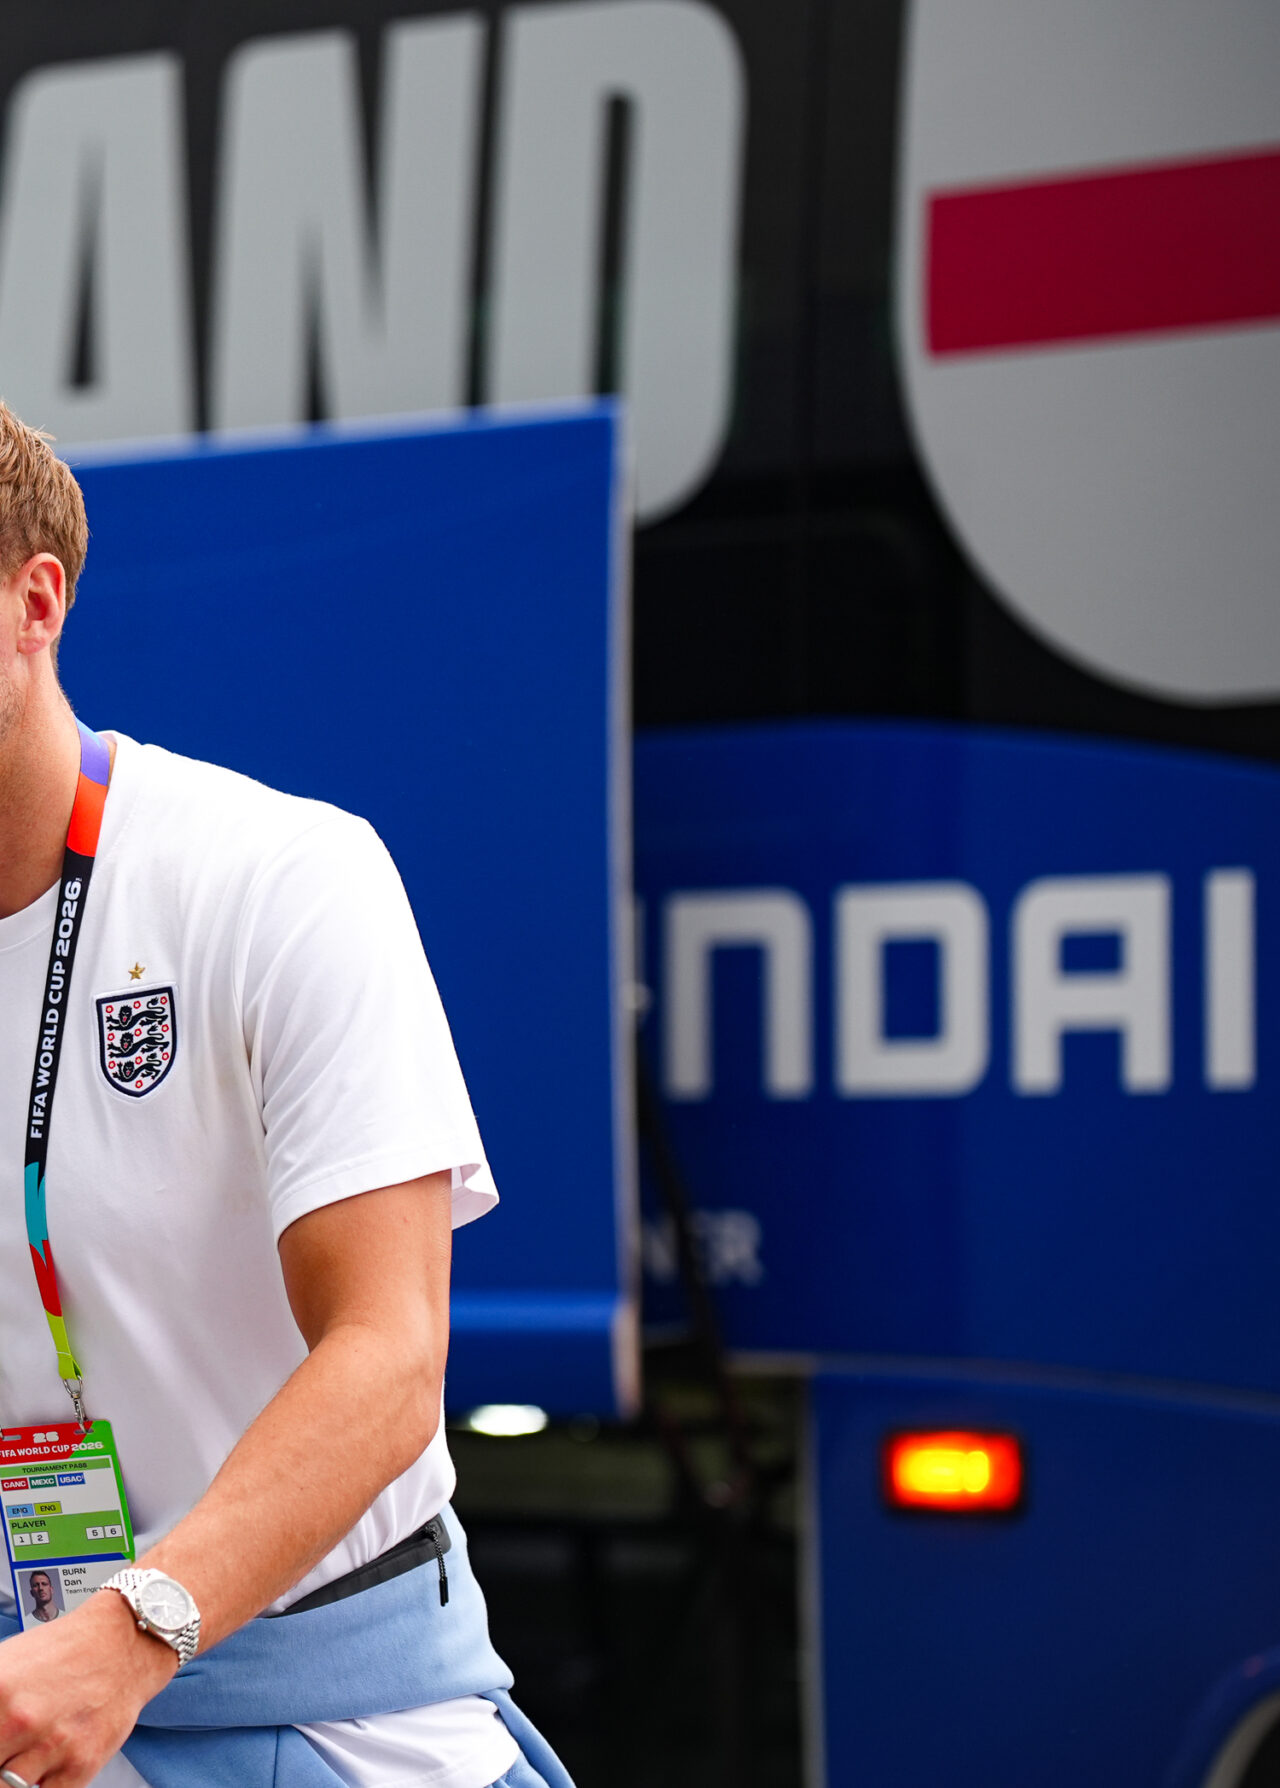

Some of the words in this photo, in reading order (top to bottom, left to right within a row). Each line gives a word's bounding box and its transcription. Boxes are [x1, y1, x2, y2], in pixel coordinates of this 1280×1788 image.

[55, 881, 82, 958] 2026
[48, 960, 67, 1004] CUP
[634, 866, 1258, 1102] NDAI
[36, 1008, 59, 1088] WORLD
[30, 1092, 48, 1140] FIFA
[32, 1431, 60, 1444] 26
[17, 1446, 51, 1456] WORLD
[51, 1444, 70, 1453] CUP
[71, 1441, 105, 1452] 2026
[22, 1463, 68, 1474] TOURNAMENT
[69, 1462, 88, 1470] PASS
[40, 1504, 57, 1512] ENG
[11, 1520, 47, 1529] PLAYER
[62, 1567, 87, 1576] BURN
[63, 1579, 82, 1587] Dan
